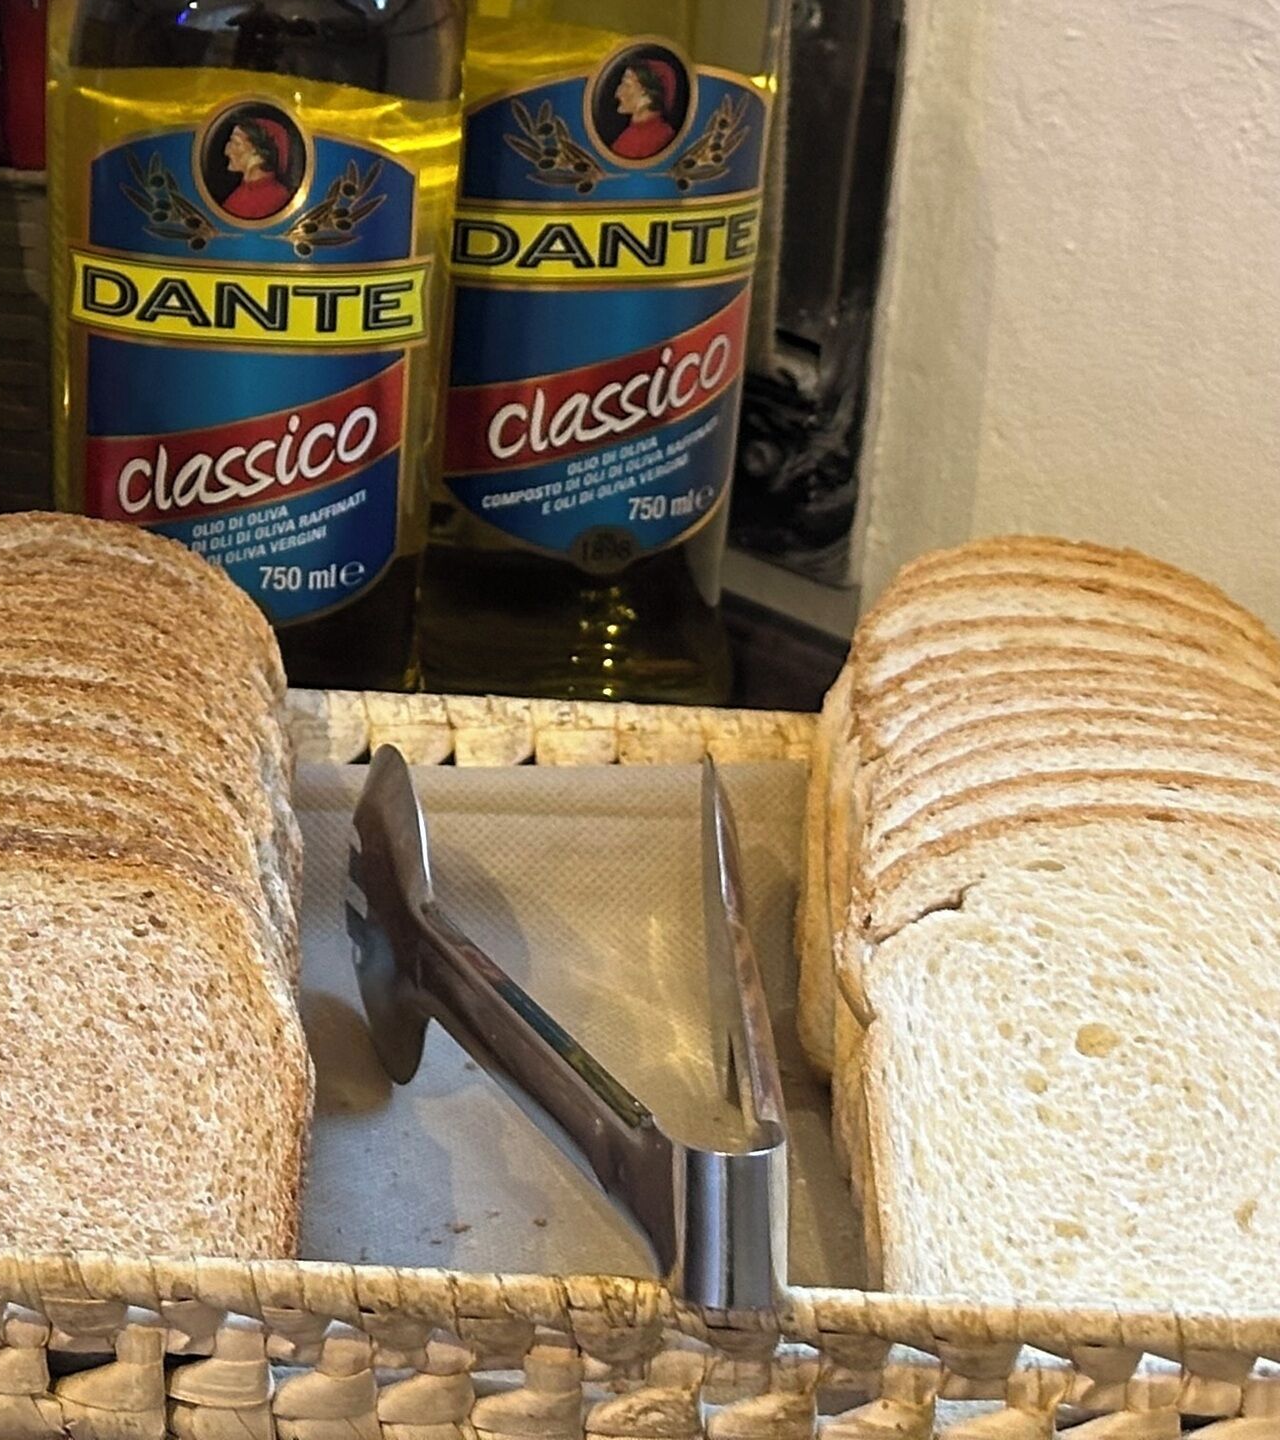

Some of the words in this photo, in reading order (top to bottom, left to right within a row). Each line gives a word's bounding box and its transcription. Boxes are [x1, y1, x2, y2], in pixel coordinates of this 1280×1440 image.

[451, 212, 759, 270] DANTE
[81, 264, 414, 333] DANTE
[567, 456, 600, 476] OLIO
[602, 452, 618, 467] DI
[619, 436, 659, 459] OLIVA
[482, 483, 563, 510] COMPOSTO
[565, 477, 582, 493] DI
[583, 470, 606, 488] OLI
[608, 463, 624, 480] DI
[625, 449, 665, 474] OLIVA
[541, 500, 551, 516] E
[554, 494, 577, 513] OLI
[579, 488, 595, 505] DI
[596, 475, 637, 500] OLIVA
[192, 518, 225, 539] OLIO
[227, 513, 243, 530] DI
[247, 503, 290, 526] OLIVA
[209, 533, 233, 551] OLI
[236, 528, 252, 544] DI
[254, 519, 296, 540] OLIVA
[298, 488, 368, 529] RAFFINATI
[628, 494, 667, 521] 750
[224, 543, 266, 565] OLIVA
[269, 524, 328, 555] VERGINI
[259, 565, 302, 592] 750
[308, 563, 337, 591] ml
